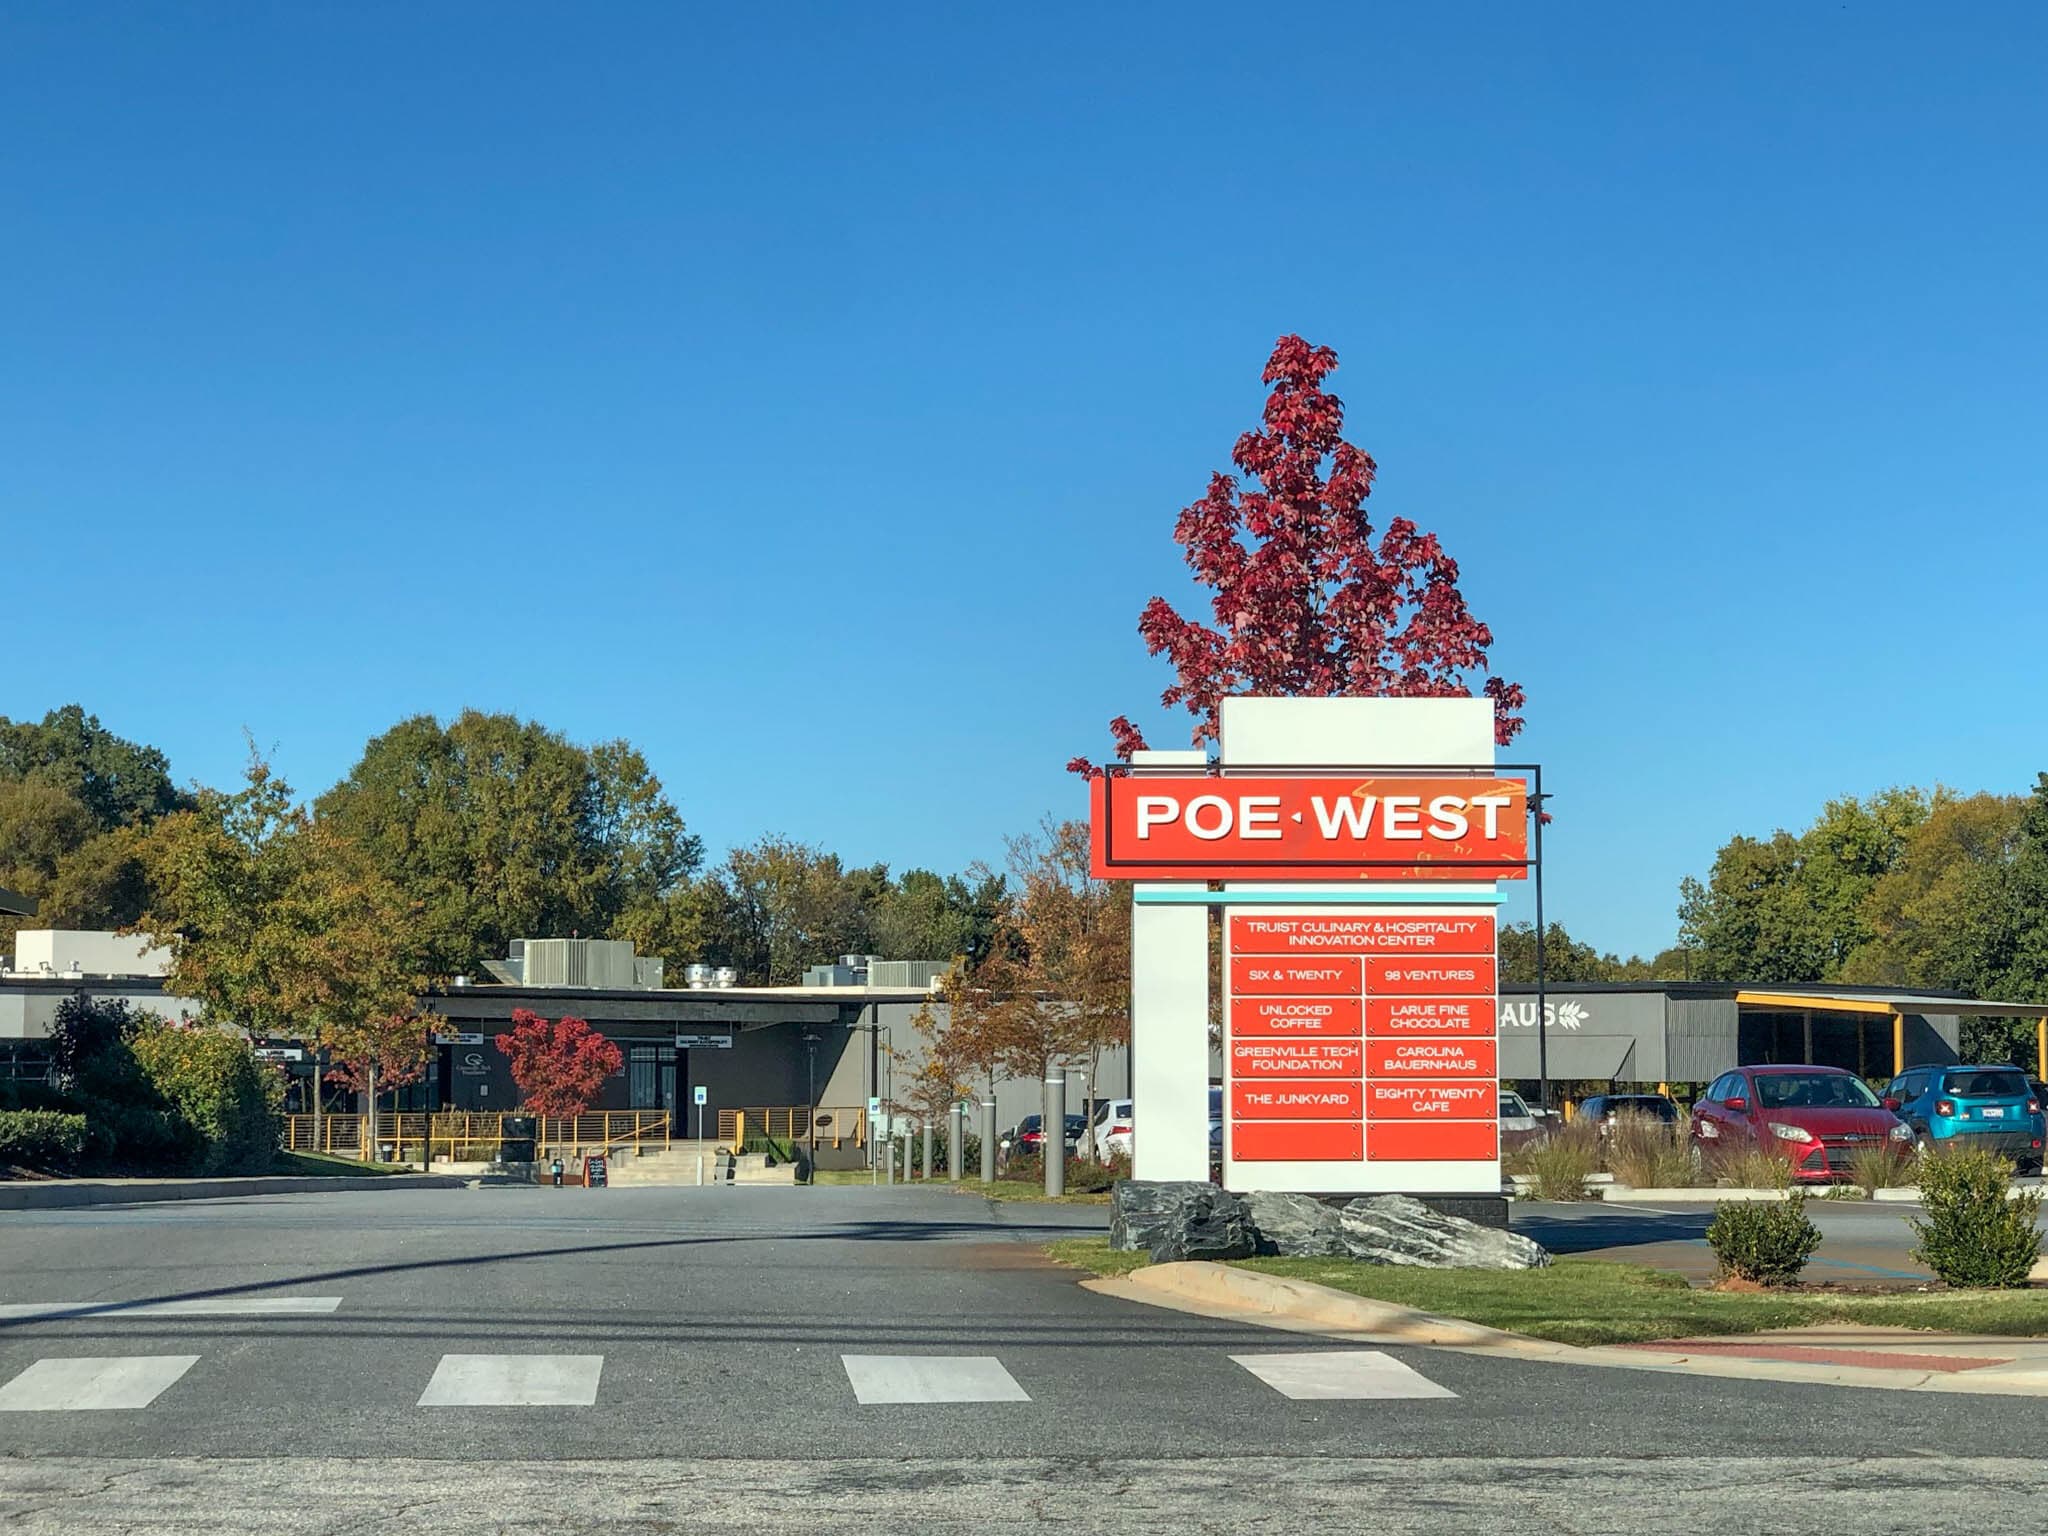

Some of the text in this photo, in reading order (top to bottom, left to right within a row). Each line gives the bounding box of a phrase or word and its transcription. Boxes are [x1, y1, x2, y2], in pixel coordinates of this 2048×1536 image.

[1136, 795, 1511, 839] POE WEST
[1248, 922, 1477, 933] TRUIST CULINARY & HOSPITALITY
[1288, 935, 1435, 946] INNOVATION CENTER
[1248, 970, 1343, 981] SIX & TWENTY
[1384, 970, 1475, 981] 98 VENTURES
[1259, 1005, 1333, 1016] UNLOCKED
[1391, 1005, 1469, 1016] LARUE FINE
[1269, 1018, 1322, 1029] COFFEE
[1390, 1018, 1470, 1029] CHOCOLATE
[1234, 1047, 1359, 1057] GREENVILLE TECH
[1396, 1047, 1464, 1057] CAROLINA
[1252, 1060, 1343, 1070] FOUNDATION
[1384, 1060, 1477, 1070] BAUERNHAUS
[1376, 1088, 1486, 1099] EIGHTY TWENTY
[1245, 1094, 1349, 1105] THE JUNKYARD
[1412, 1102, 1450, 1112] CAFE
